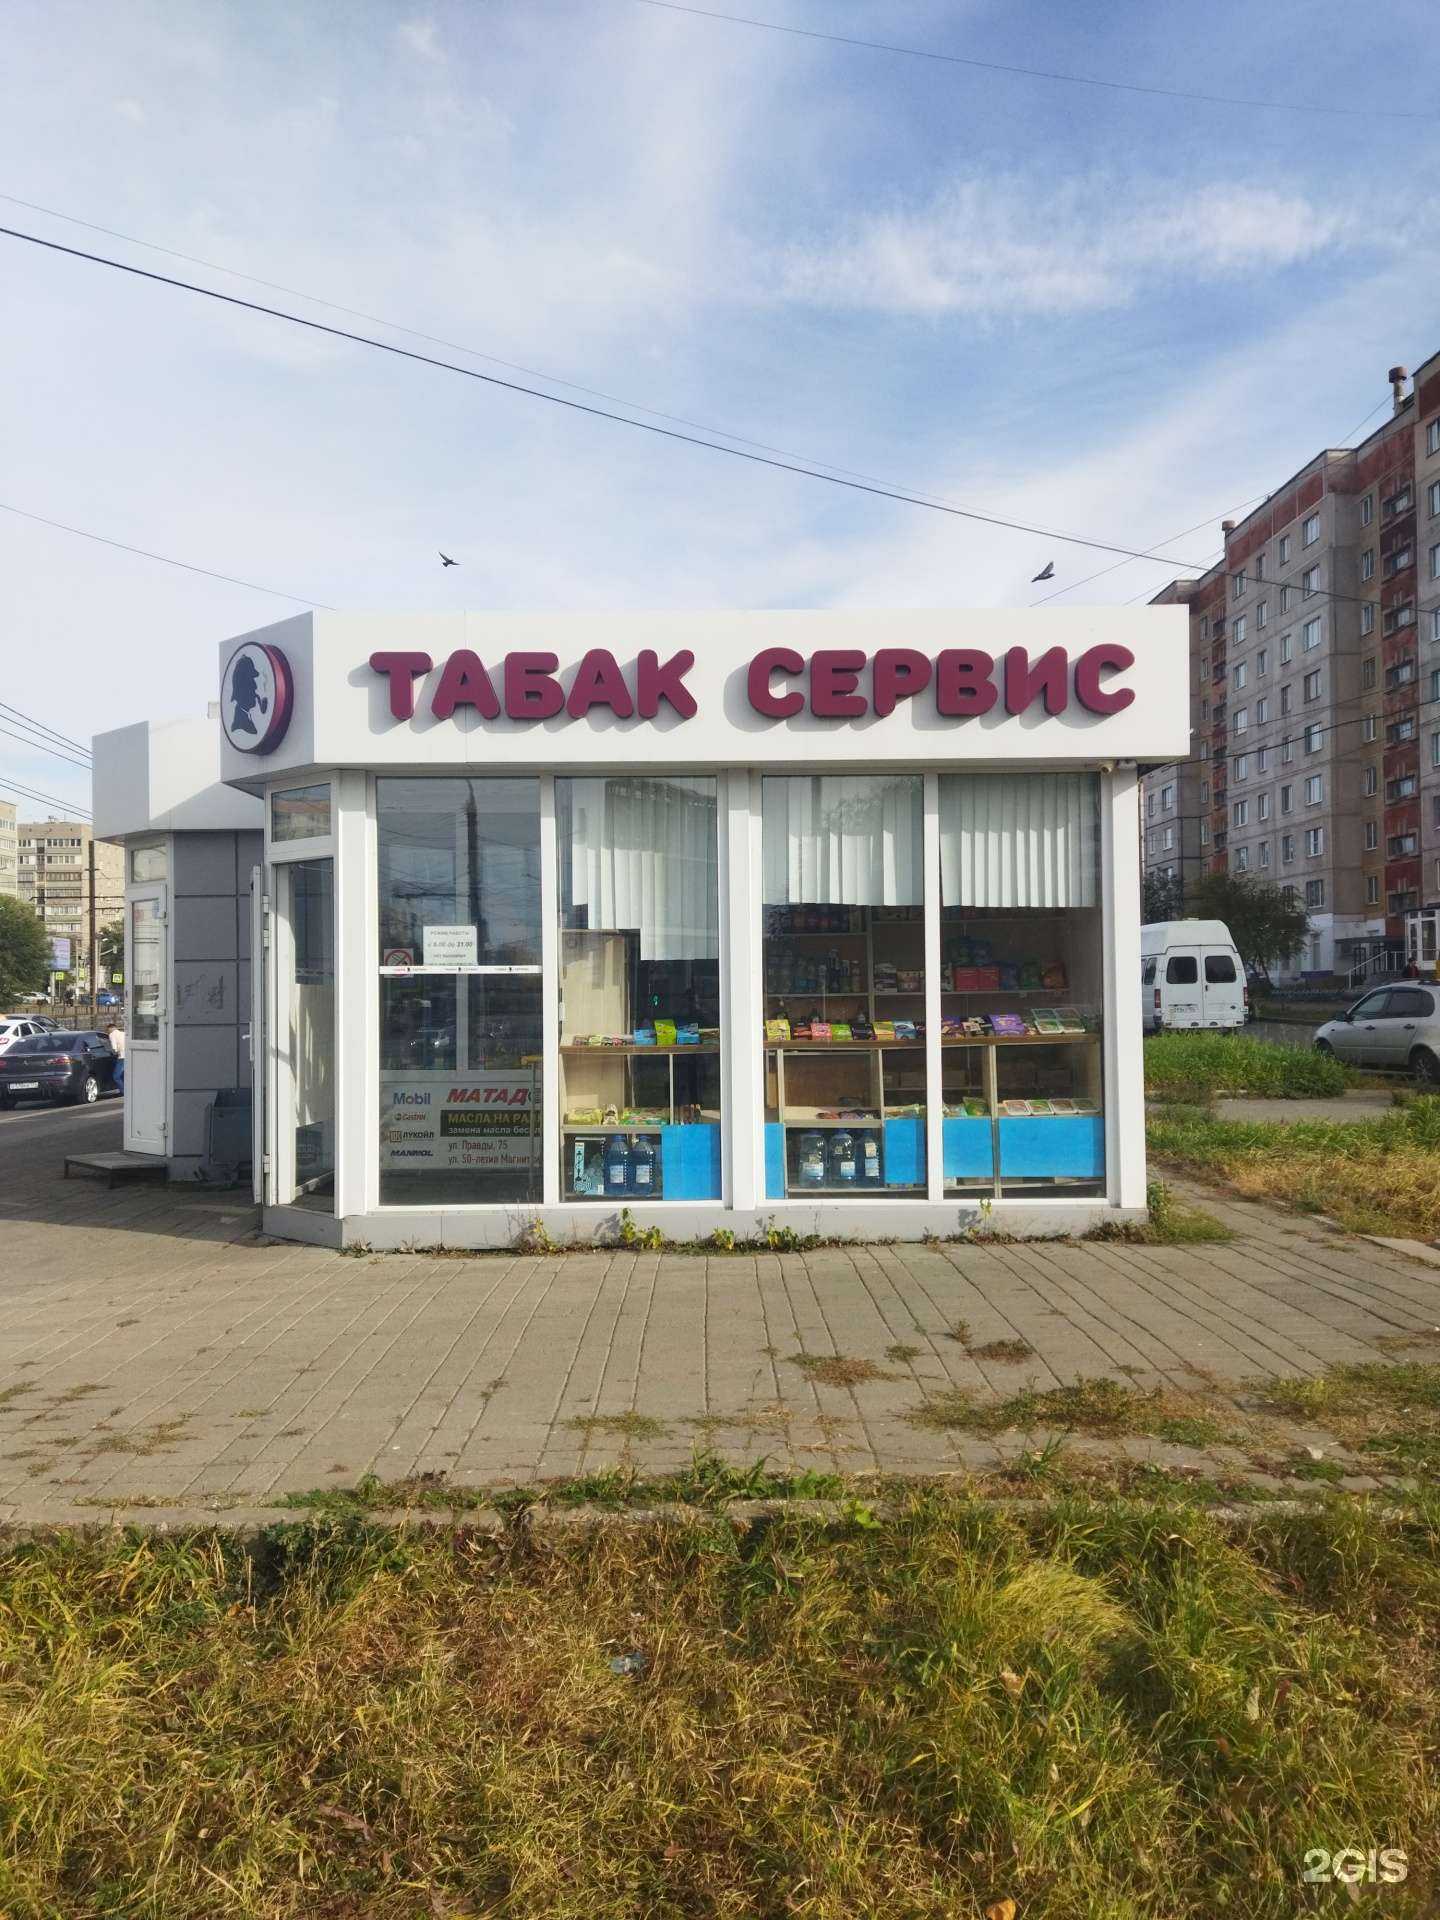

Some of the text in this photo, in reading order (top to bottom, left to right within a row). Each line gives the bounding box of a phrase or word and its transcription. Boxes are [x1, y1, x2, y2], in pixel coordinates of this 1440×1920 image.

[369, 643, 1135, 720] ТАБАК СЕРВИС
[393, 1092, 431, 1105] Mobil
[446, 1088, 531, 1106] МАТАД
[448, 1113, 490, 1124] МАСЛА
[494, 1113, 510, 1124] НА
[403, 1130, 434, 1139] ЛУКОЙЛ
[498, 1140, 508, 1150] 75
